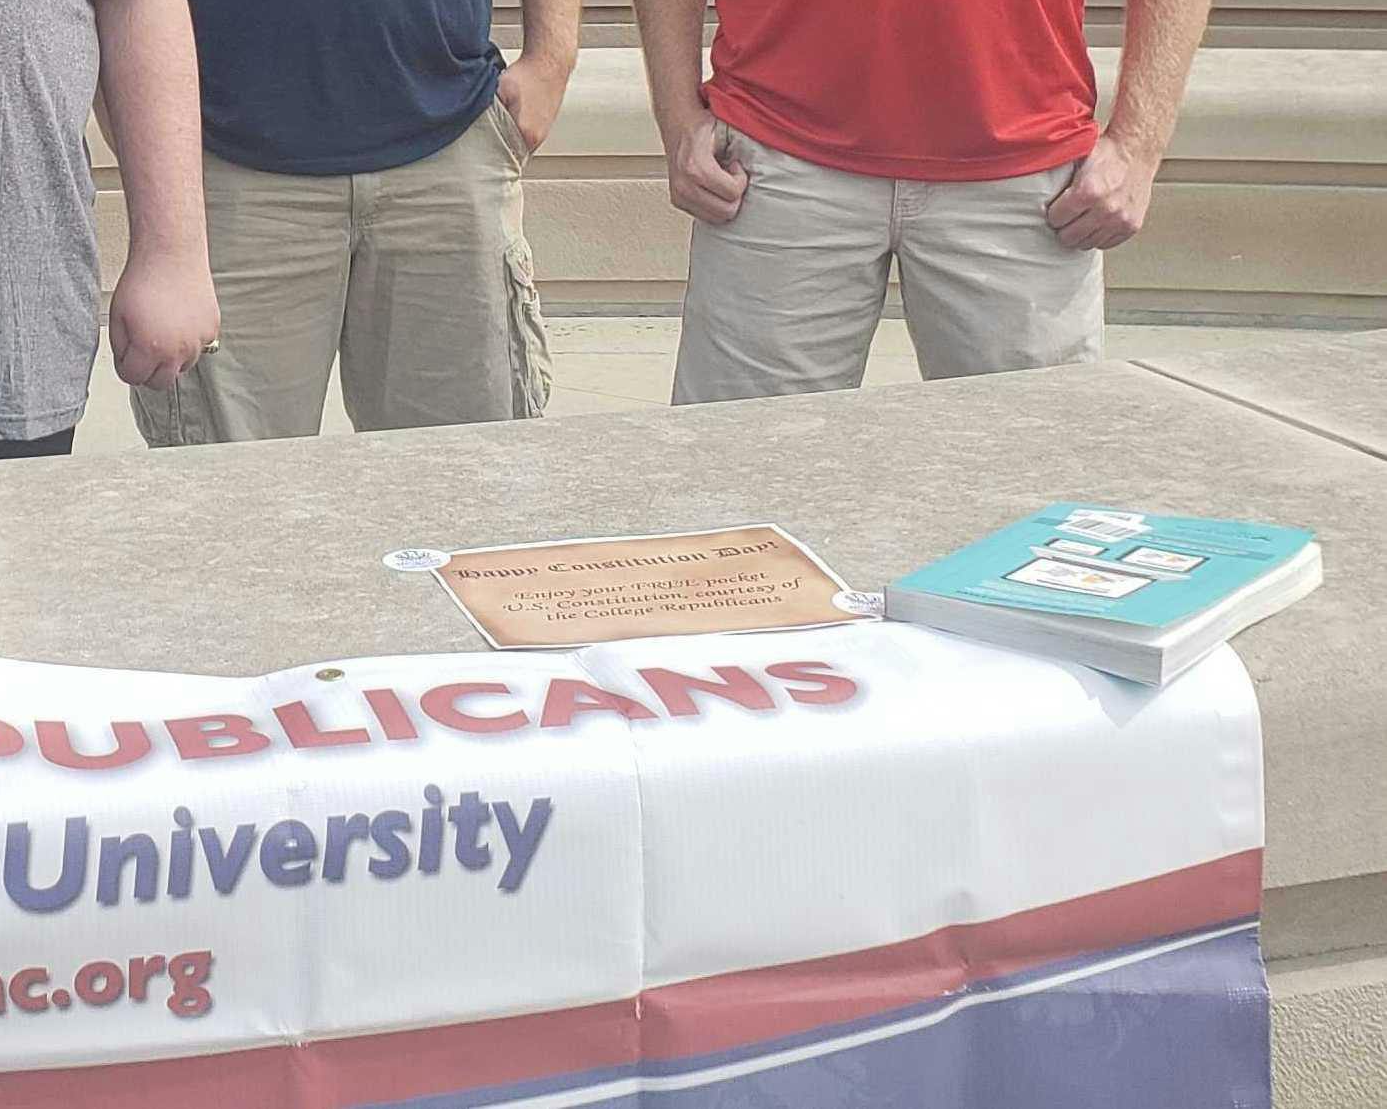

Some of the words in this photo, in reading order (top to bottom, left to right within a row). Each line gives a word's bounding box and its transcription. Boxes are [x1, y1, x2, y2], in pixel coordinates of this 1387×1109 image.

[453, 566, 539, 581] Happy
[548, 551, 708, 573] Constitution
[710, 541, 780, 559] Day!
[503, 601, 550, 613] U.S.
[695, 583, 776, 600] courtesy
[782, 576, 803, 591] of
[514, 588, 576, 603] Enjoy
[582, 583, 625, 598] your
[705, 571, 770, 588] pocket
[546, 610, 578, 623] the
[583, 605, 654, 622] College
[660, 594, 784, 613] Republicans
[1, 784, 553, 893] University
